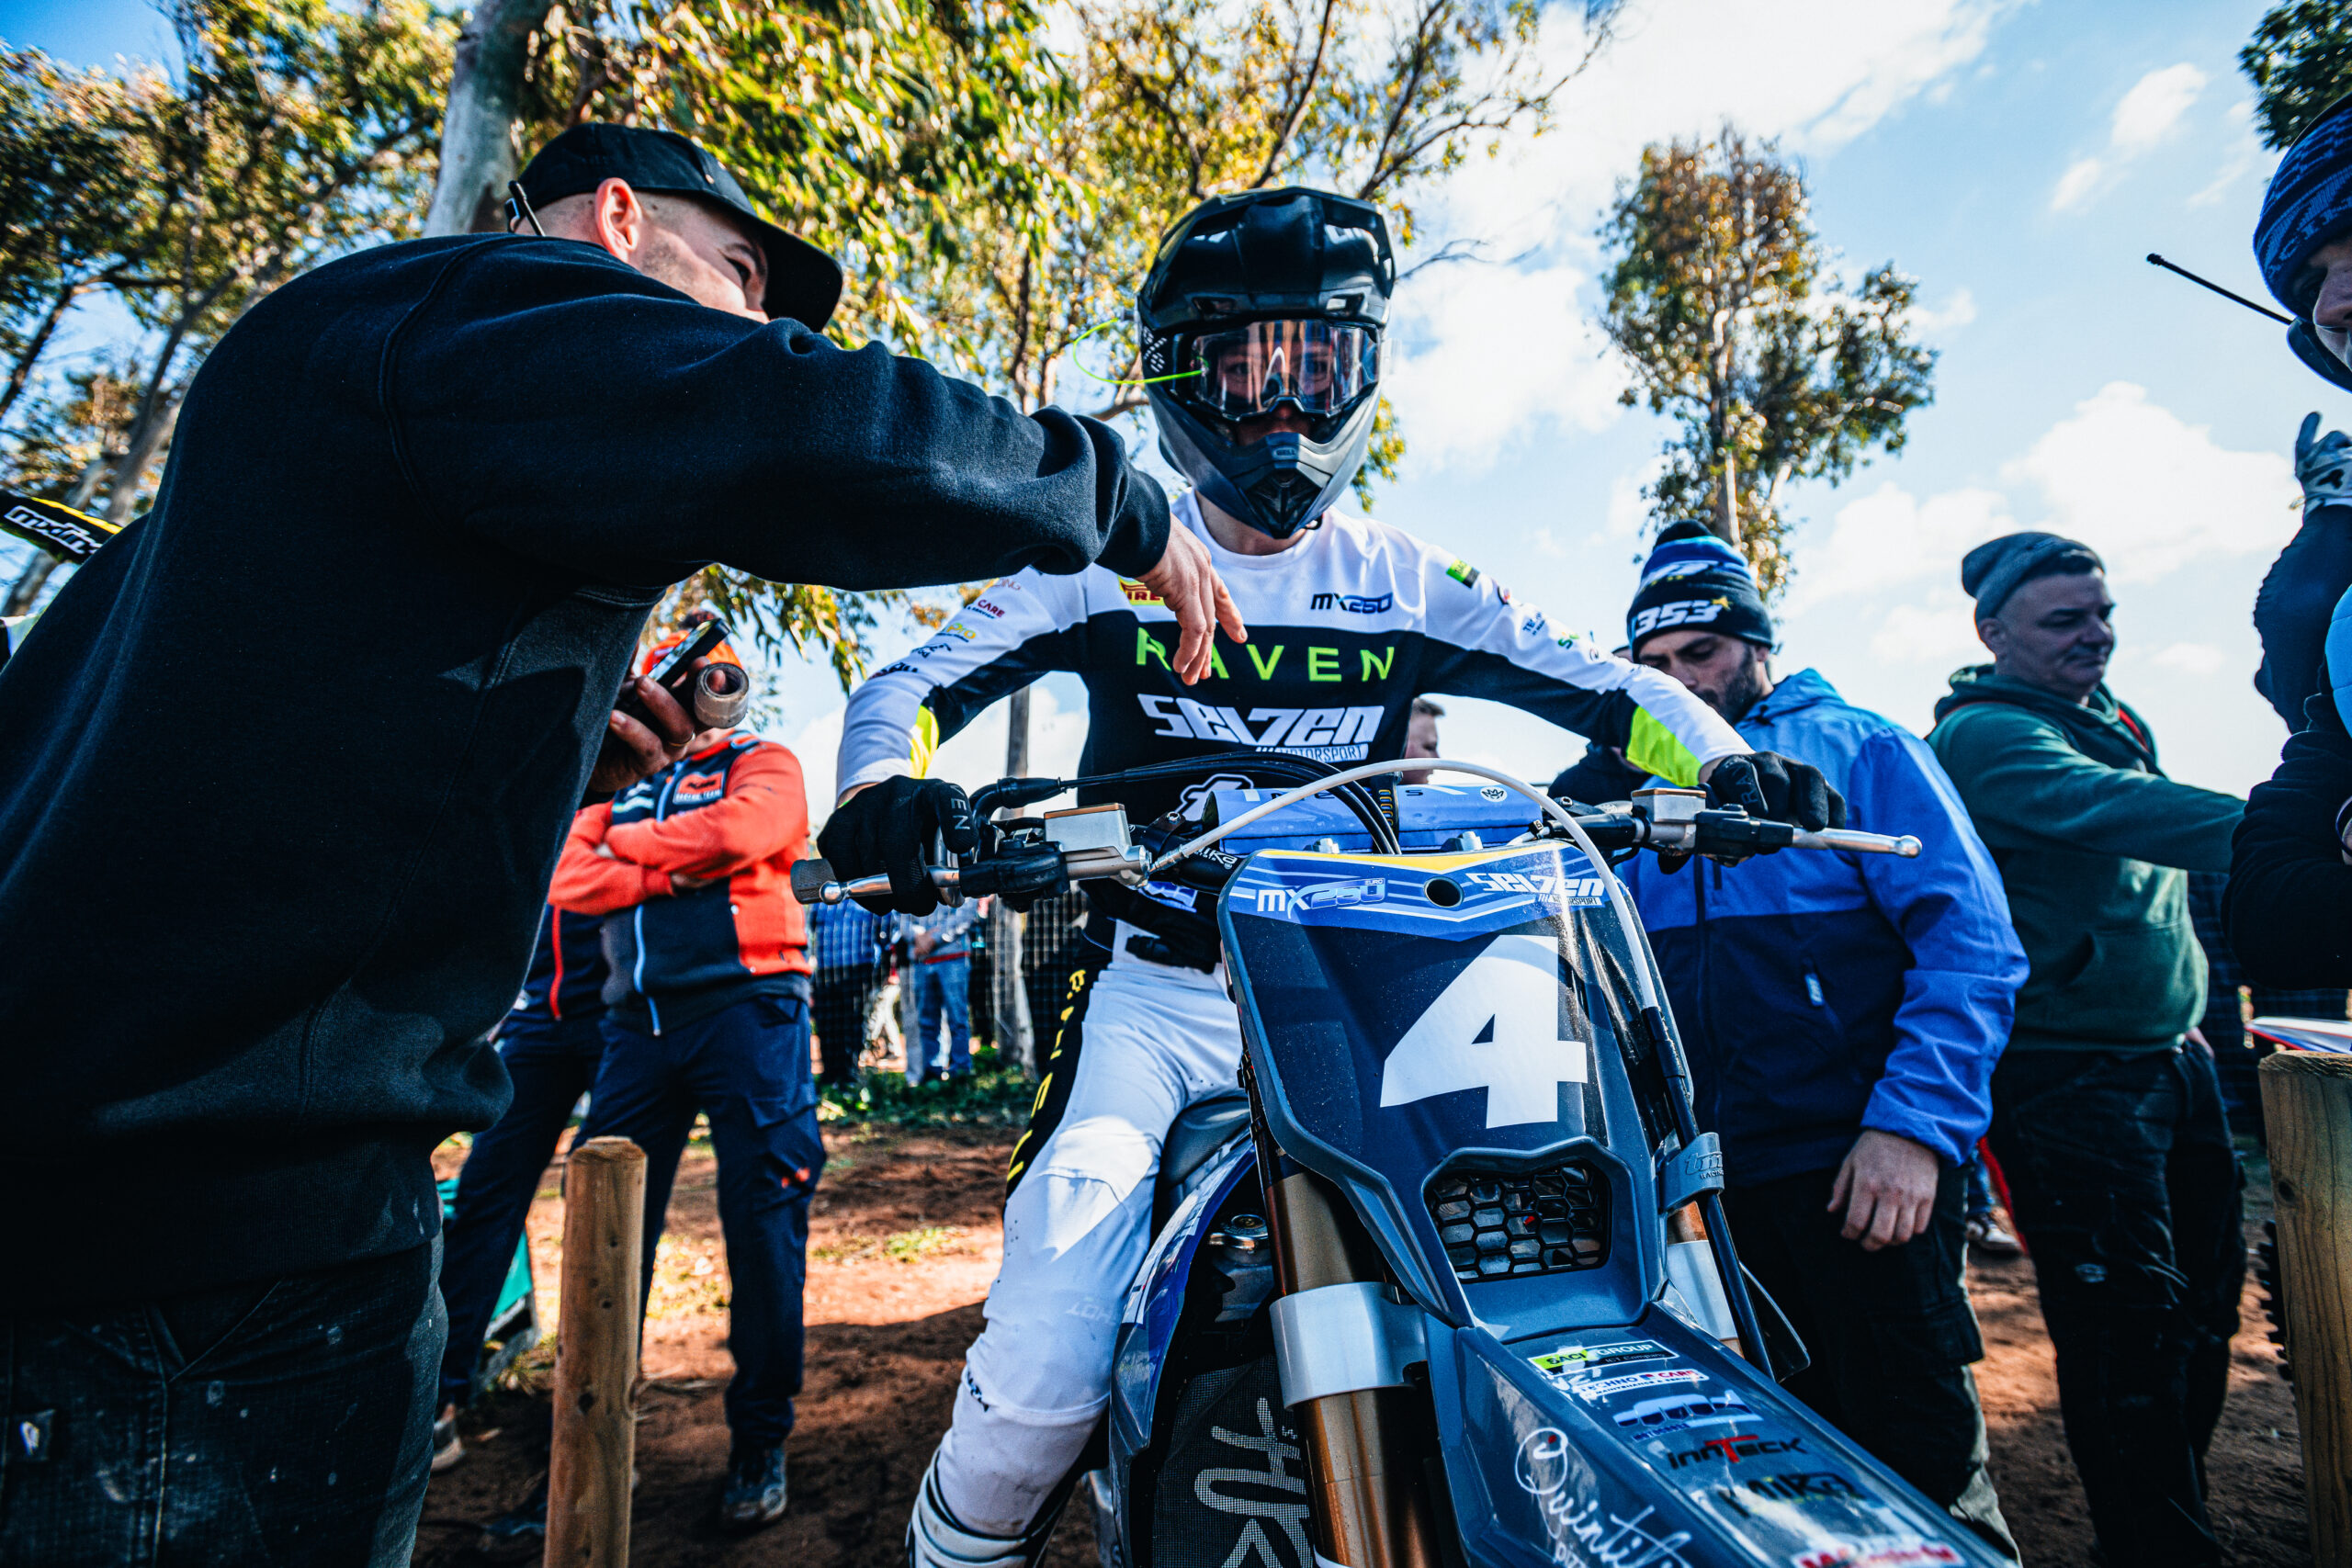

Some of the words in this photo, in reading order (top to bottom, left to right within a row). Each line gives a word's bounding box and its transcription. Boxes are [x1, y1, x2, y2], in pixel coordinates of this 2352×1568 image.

[978, 599, 1005, 618] CARE
[1380, 934, 1588, 1129] 4
[1596, 1343, 1654, 1357] GROUP
